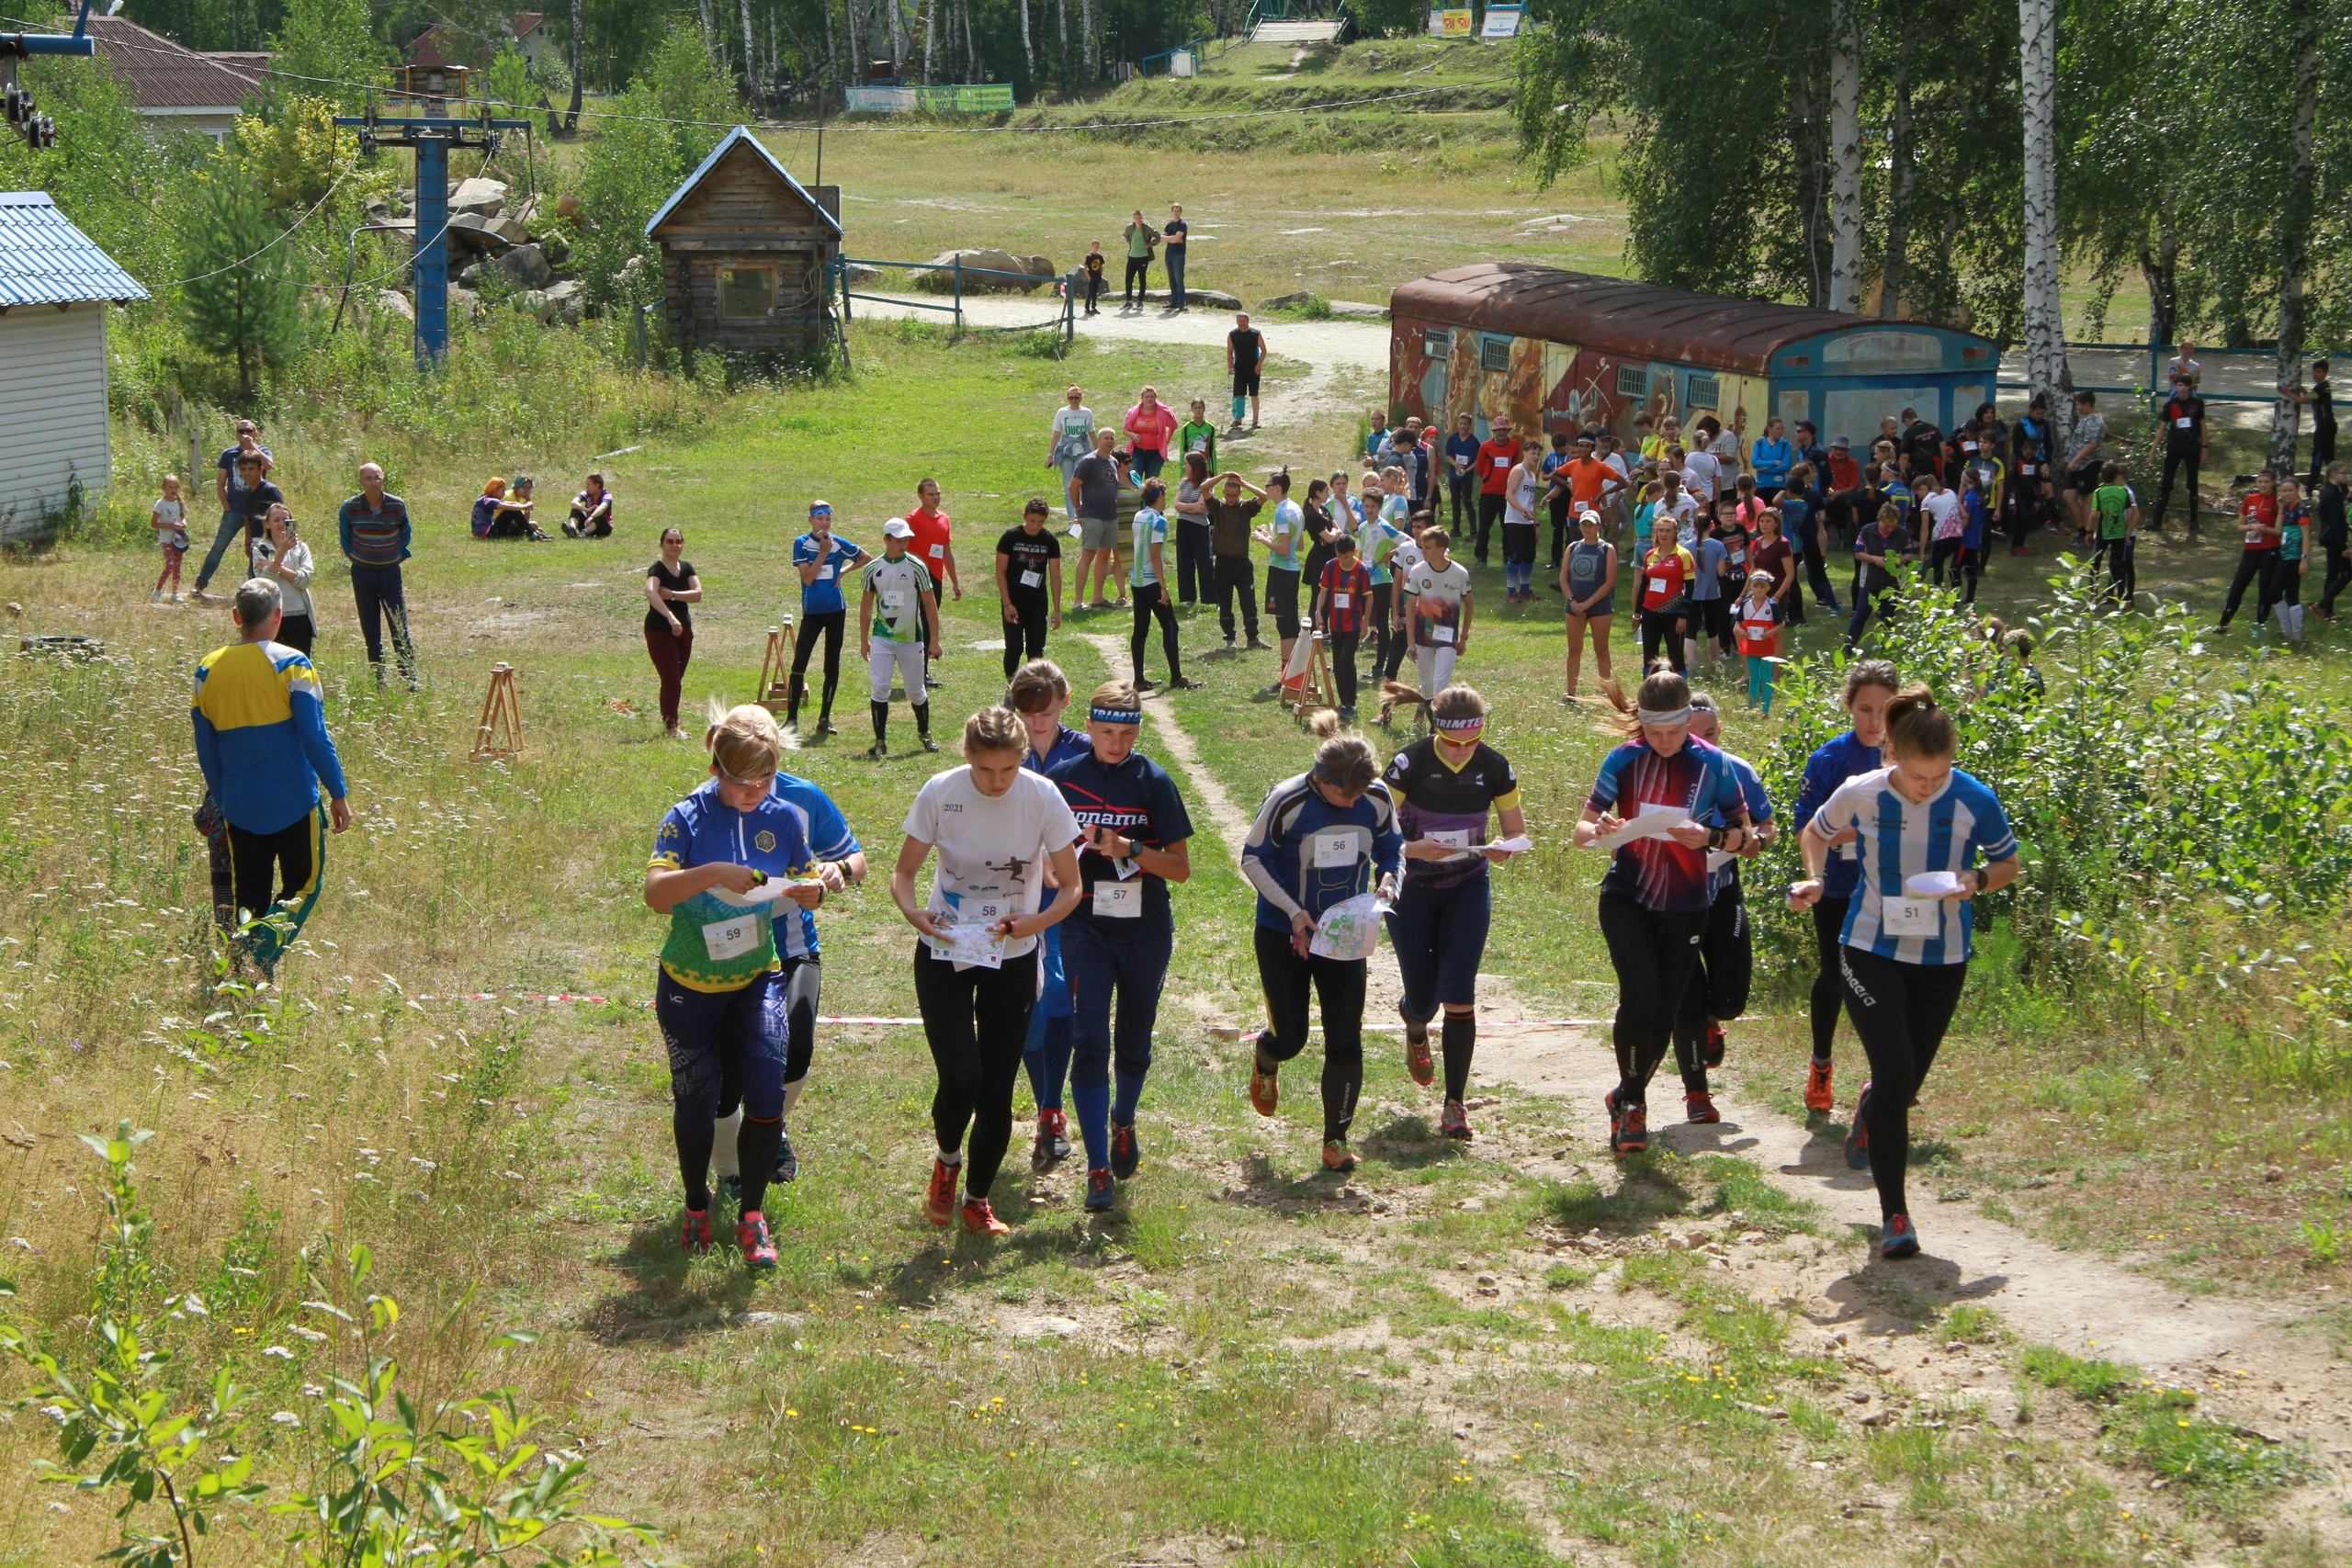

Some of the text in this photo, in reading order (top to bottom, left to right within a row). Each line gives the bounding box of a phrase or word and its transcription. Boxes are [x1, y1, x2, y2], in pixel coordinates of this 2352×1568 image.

[1093, 708, 1141, 722] TRIMTE
[944, 804, 963, 812] 2021
[1333, 840, 1346, 851] 56
[1113, 889, 1127, 900] 57
[982, 906, 997, 917] 58
[1905, 907, 1919, 919] 51
[726, 928, 741, 941] 59
